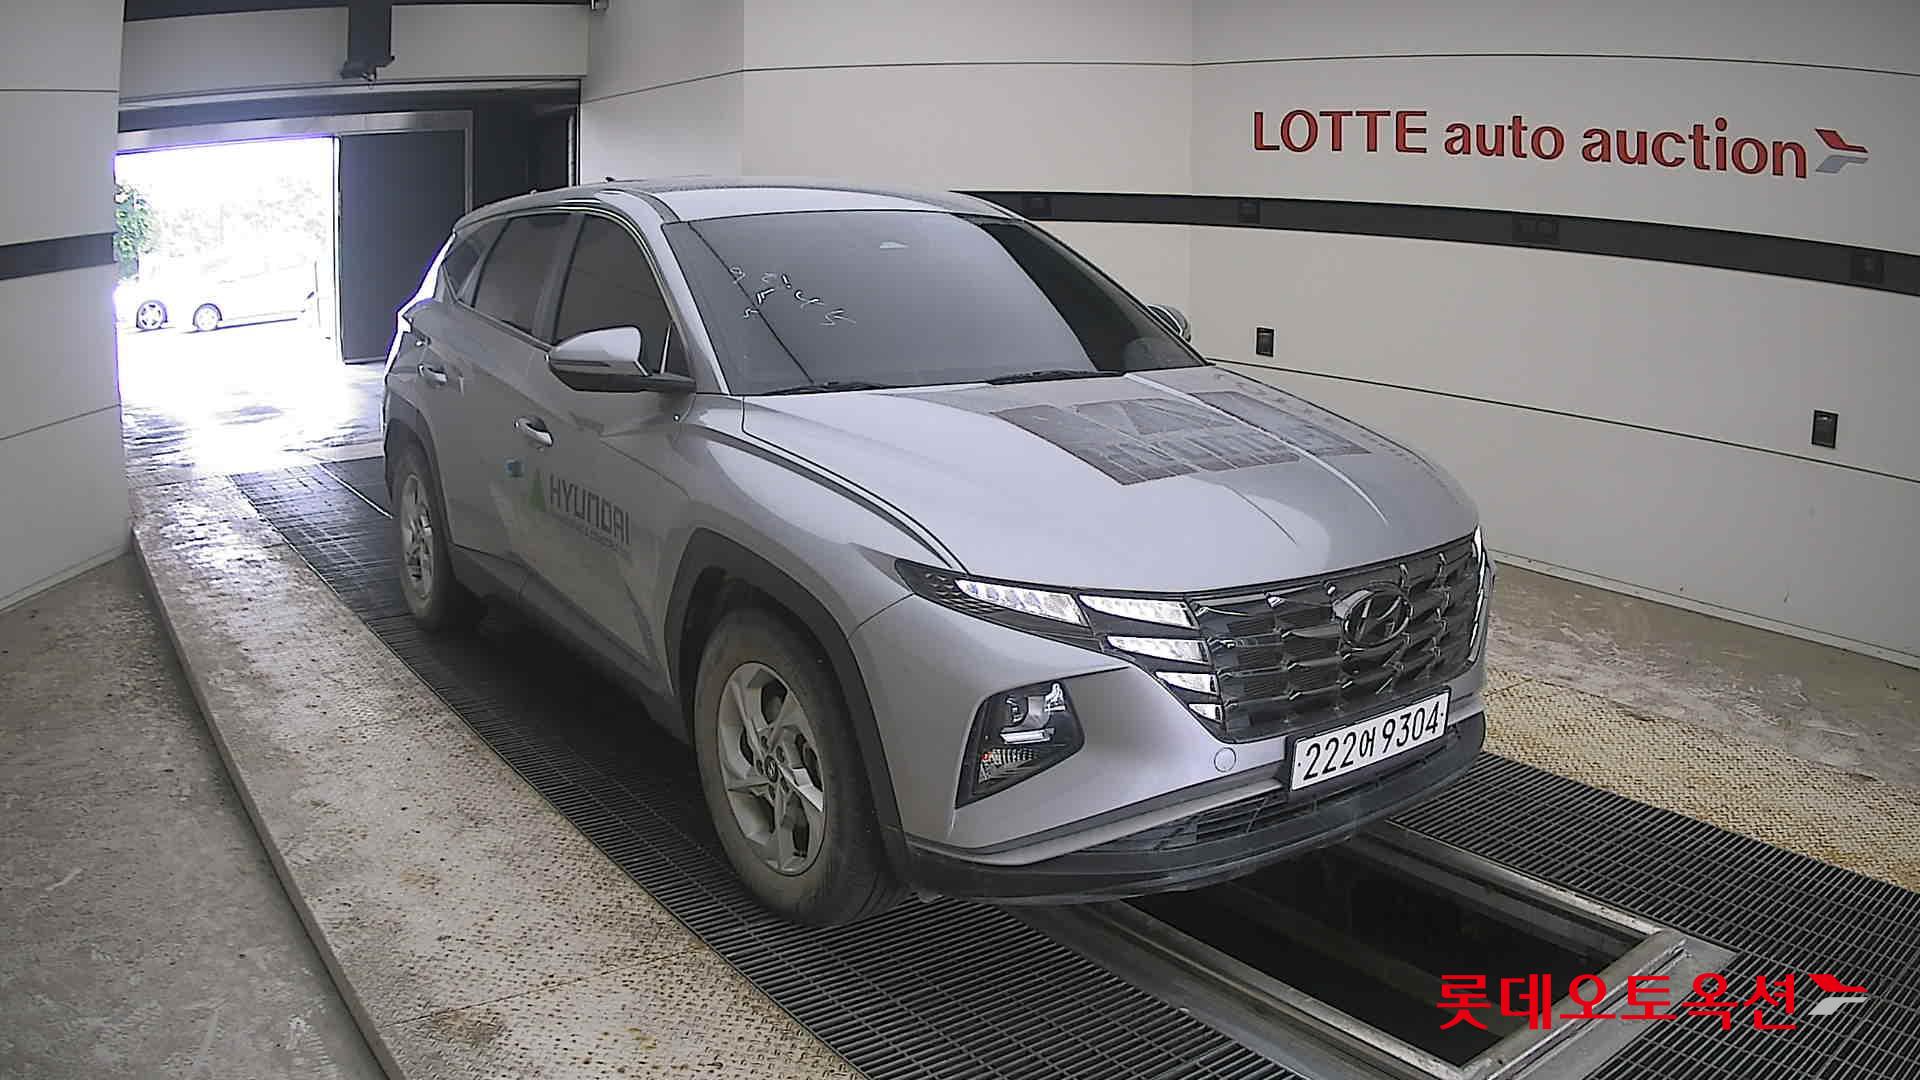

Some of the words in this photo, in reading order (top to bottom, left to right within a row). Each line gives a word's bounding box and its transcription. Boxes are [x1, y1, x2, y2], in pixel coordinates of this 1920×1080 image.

[1254, 109, 1427, 153] LOTTE
[1444, 115, 1565, 160] auto
[1582, 117, 1807, 178] auction
[549, 473, 632, 545] HYUNDAI
[1382, 701, 1440, 754] 9304
